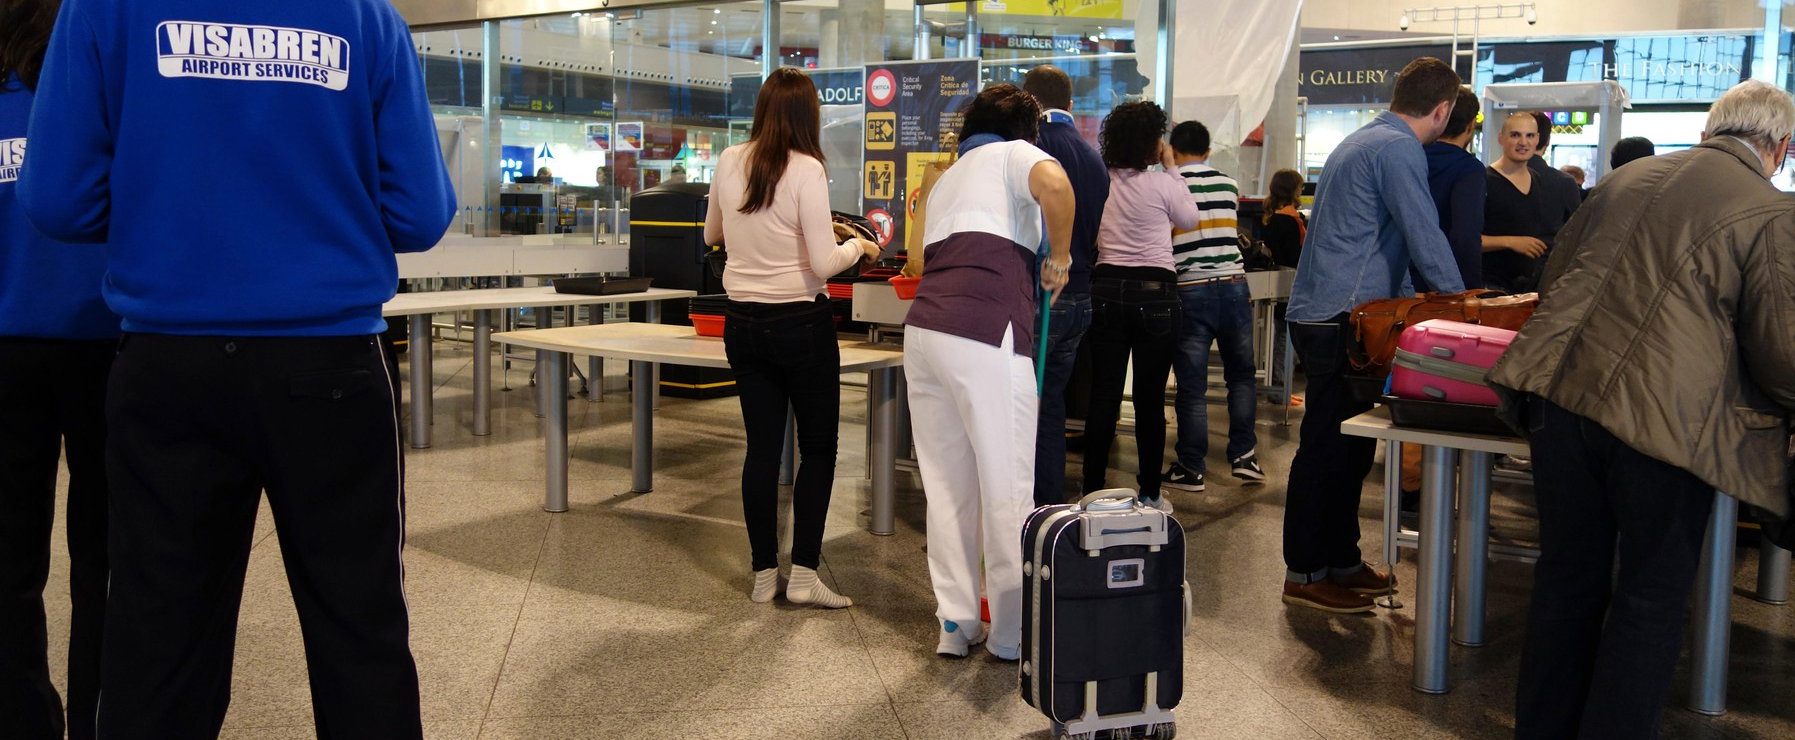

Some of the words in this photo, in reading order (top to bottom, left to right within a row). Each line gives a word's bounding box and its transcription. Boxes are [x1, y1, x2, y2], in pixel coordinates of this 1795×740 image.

[165, 23, 341, 69] VISABREN
[1007, 37, 1052, 49] BURGER
[1054, 39, 1083, 50] KING
[182, 59, 251, 77] AIRPORT
[255, 62, 329, 84] SERVICES
[1310, 69, 1389, 86] GALLERY
[1587, 61, 1632, 78] THE
[1641, 61, 1743, 77] FASHION
[902, 83, 922, 91] Security
[940, 89, 970, 97] Seguridad
